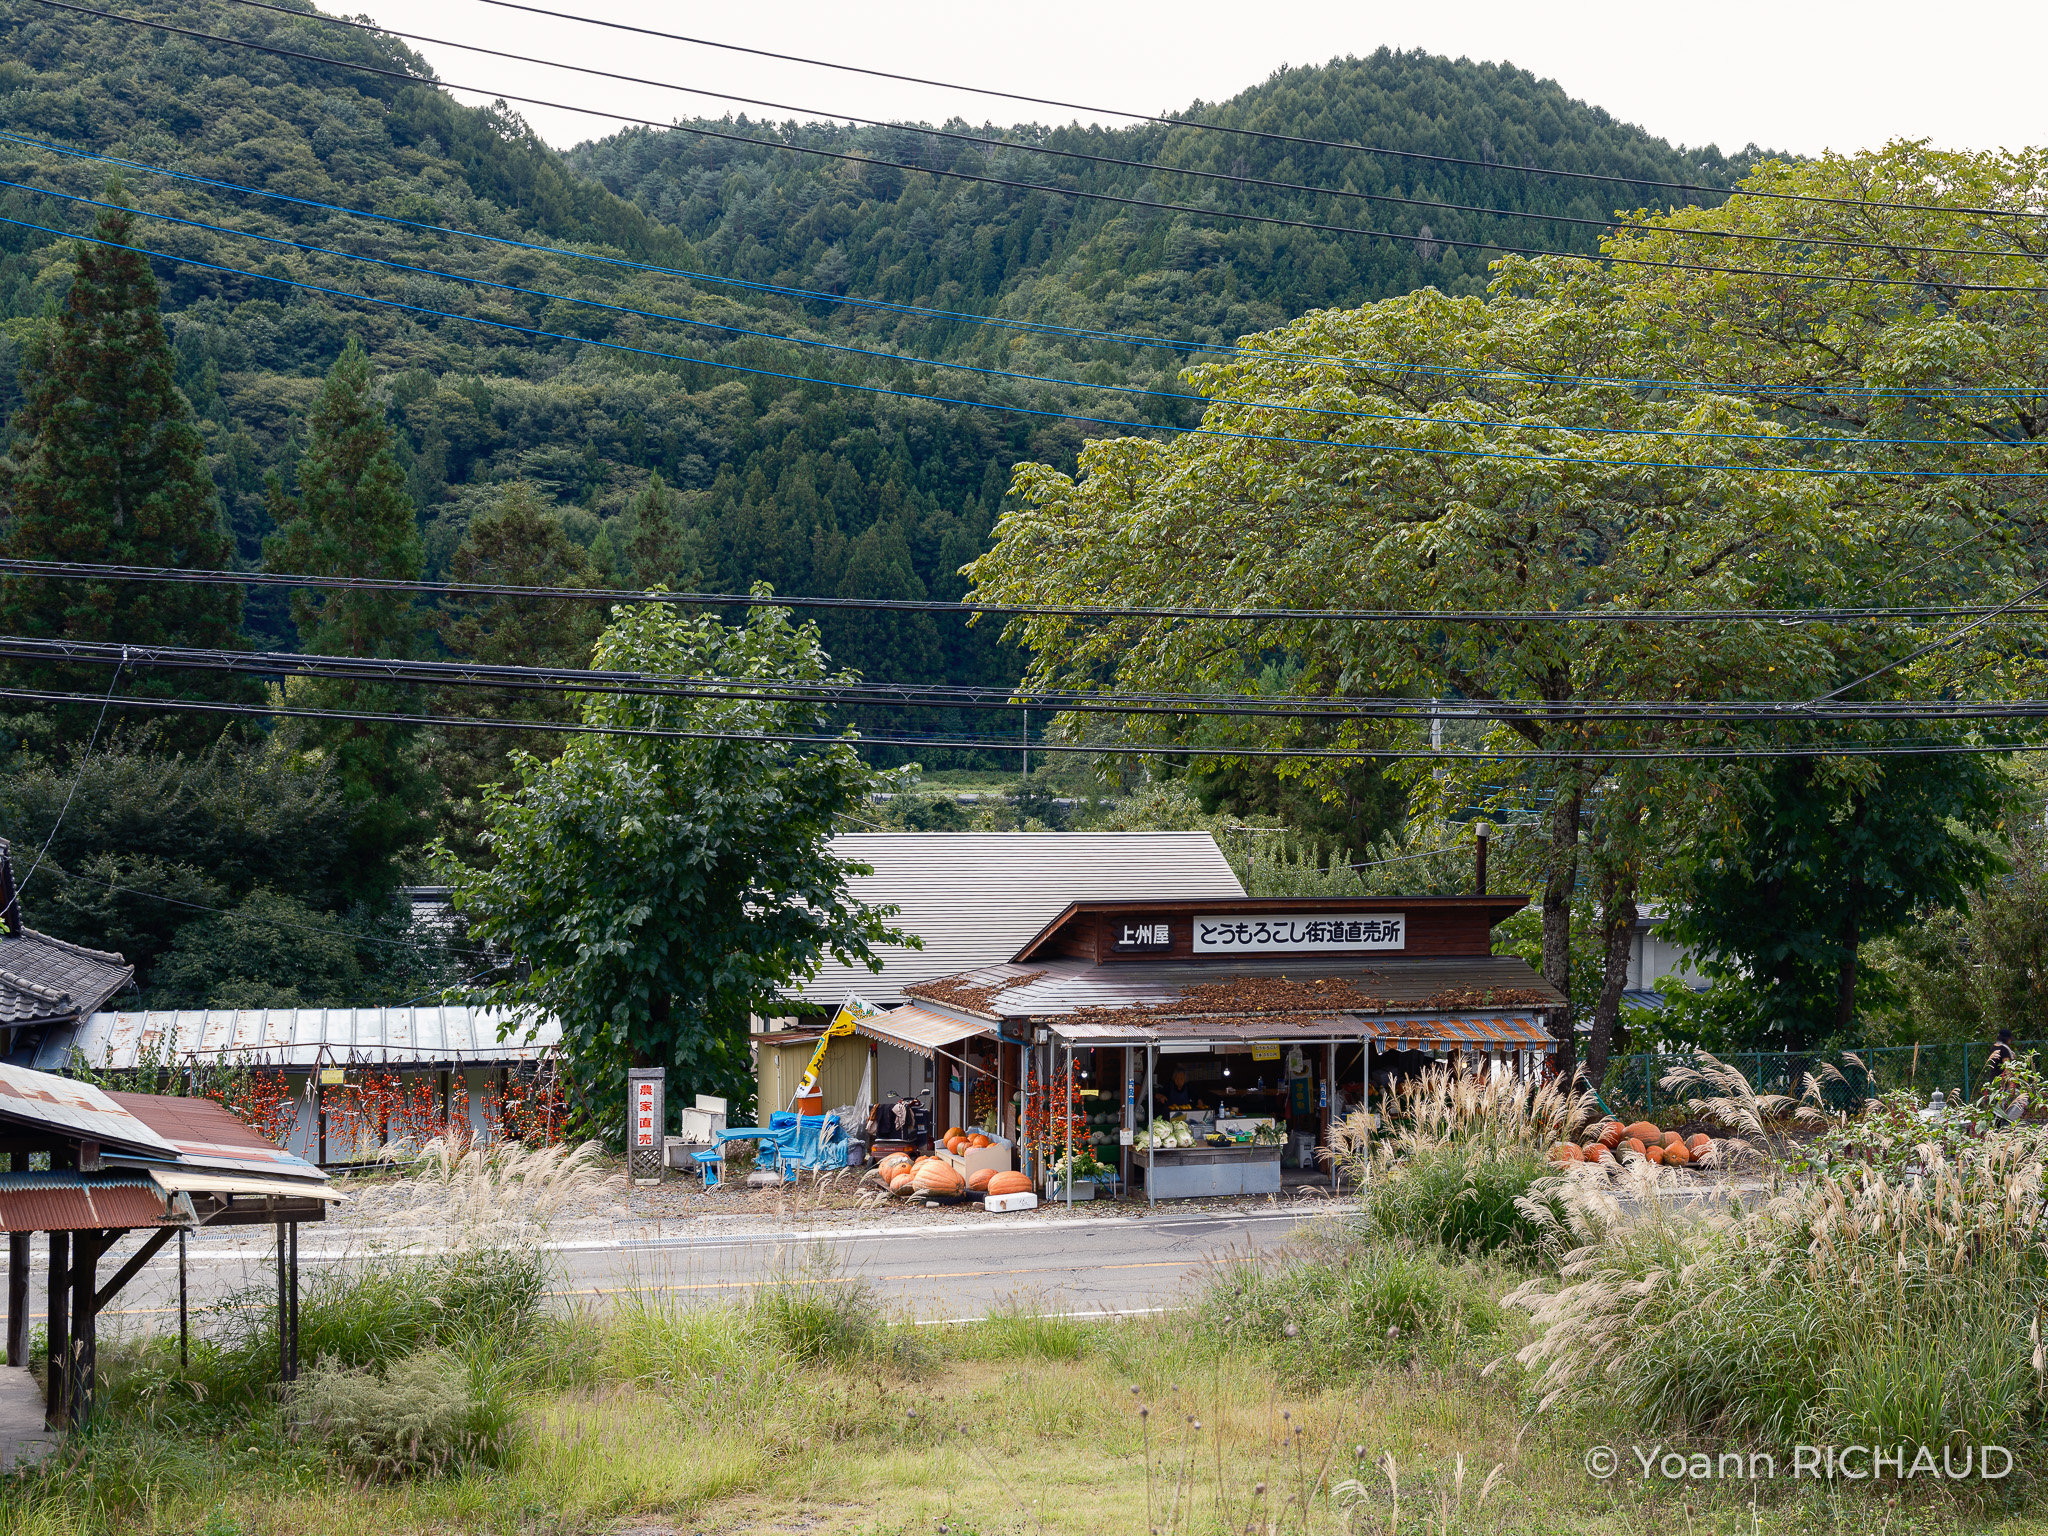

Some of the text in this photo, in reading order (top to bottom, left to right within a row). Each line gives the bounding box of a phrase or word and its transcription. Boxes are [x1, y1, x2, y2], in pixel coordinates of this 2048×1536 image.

[1118, 924, 1170, 945] 上州屋
[1200, 920, 1401, 945] とうもろこし街道直売所
[639, 1084, 653, 1145] 農家直売
